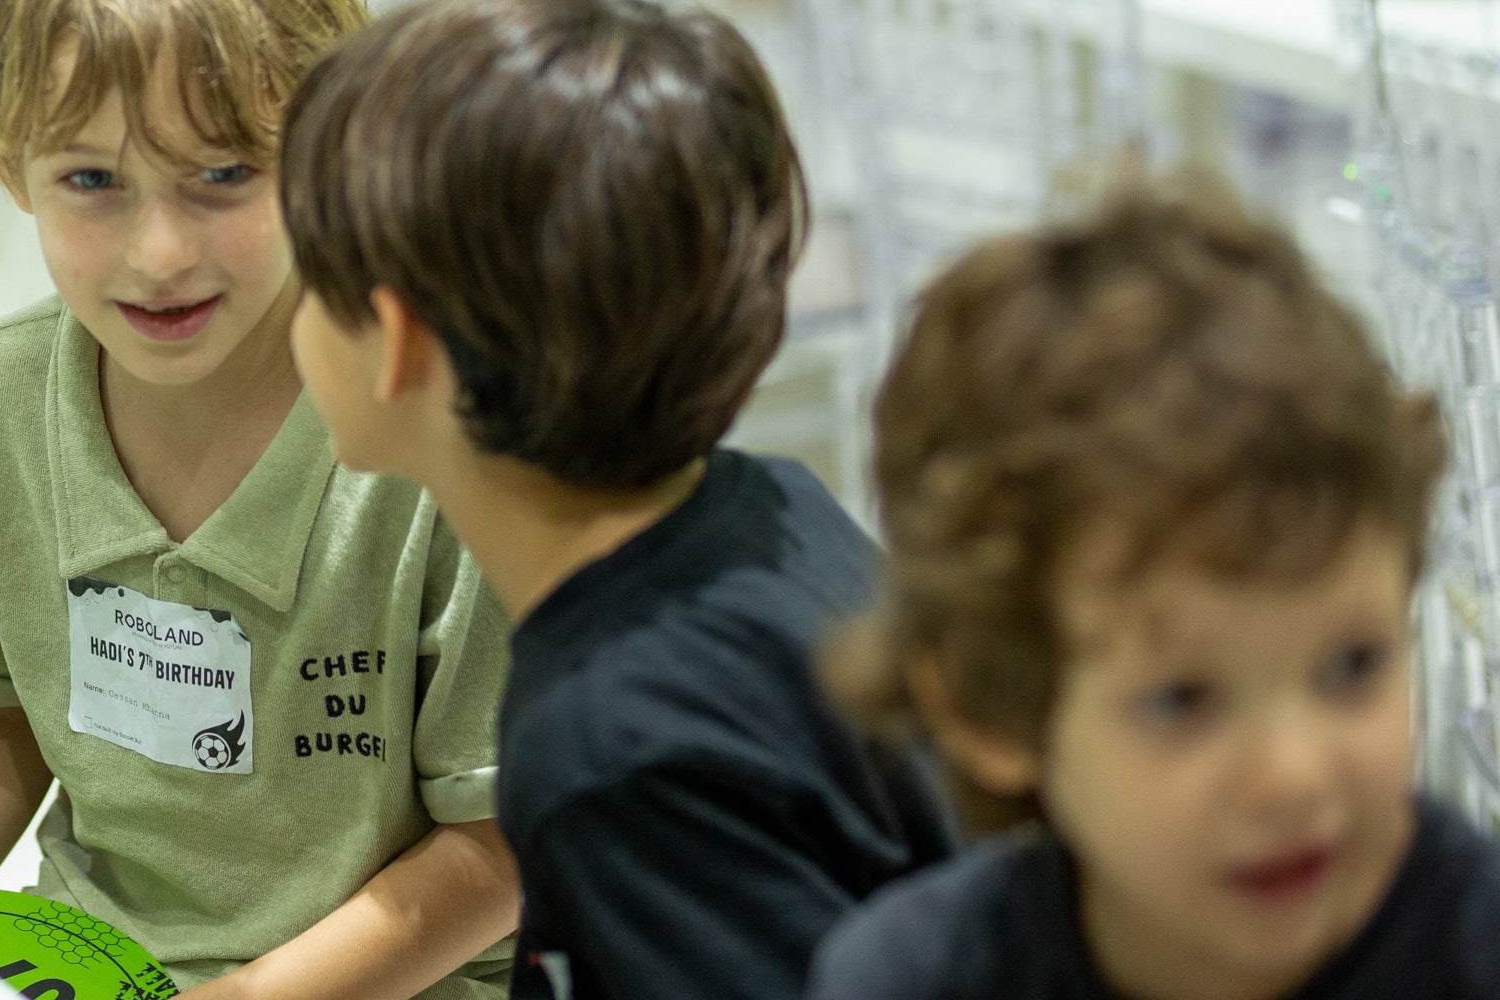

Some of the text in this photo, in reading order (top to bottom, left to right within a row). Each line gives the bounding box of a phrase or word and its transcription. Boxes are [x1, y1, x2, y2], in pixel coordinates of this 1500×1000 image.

[114, 609, 204, 647] ROBOLAND
[90, 636, 135, 668] HADI'S
[156, 660, 235, 690] BIRTHDAY
[83, 681, 105, 695] Name:
[325, 695, 366, 717] DU
[295, 732, 386, 762] BURGE
